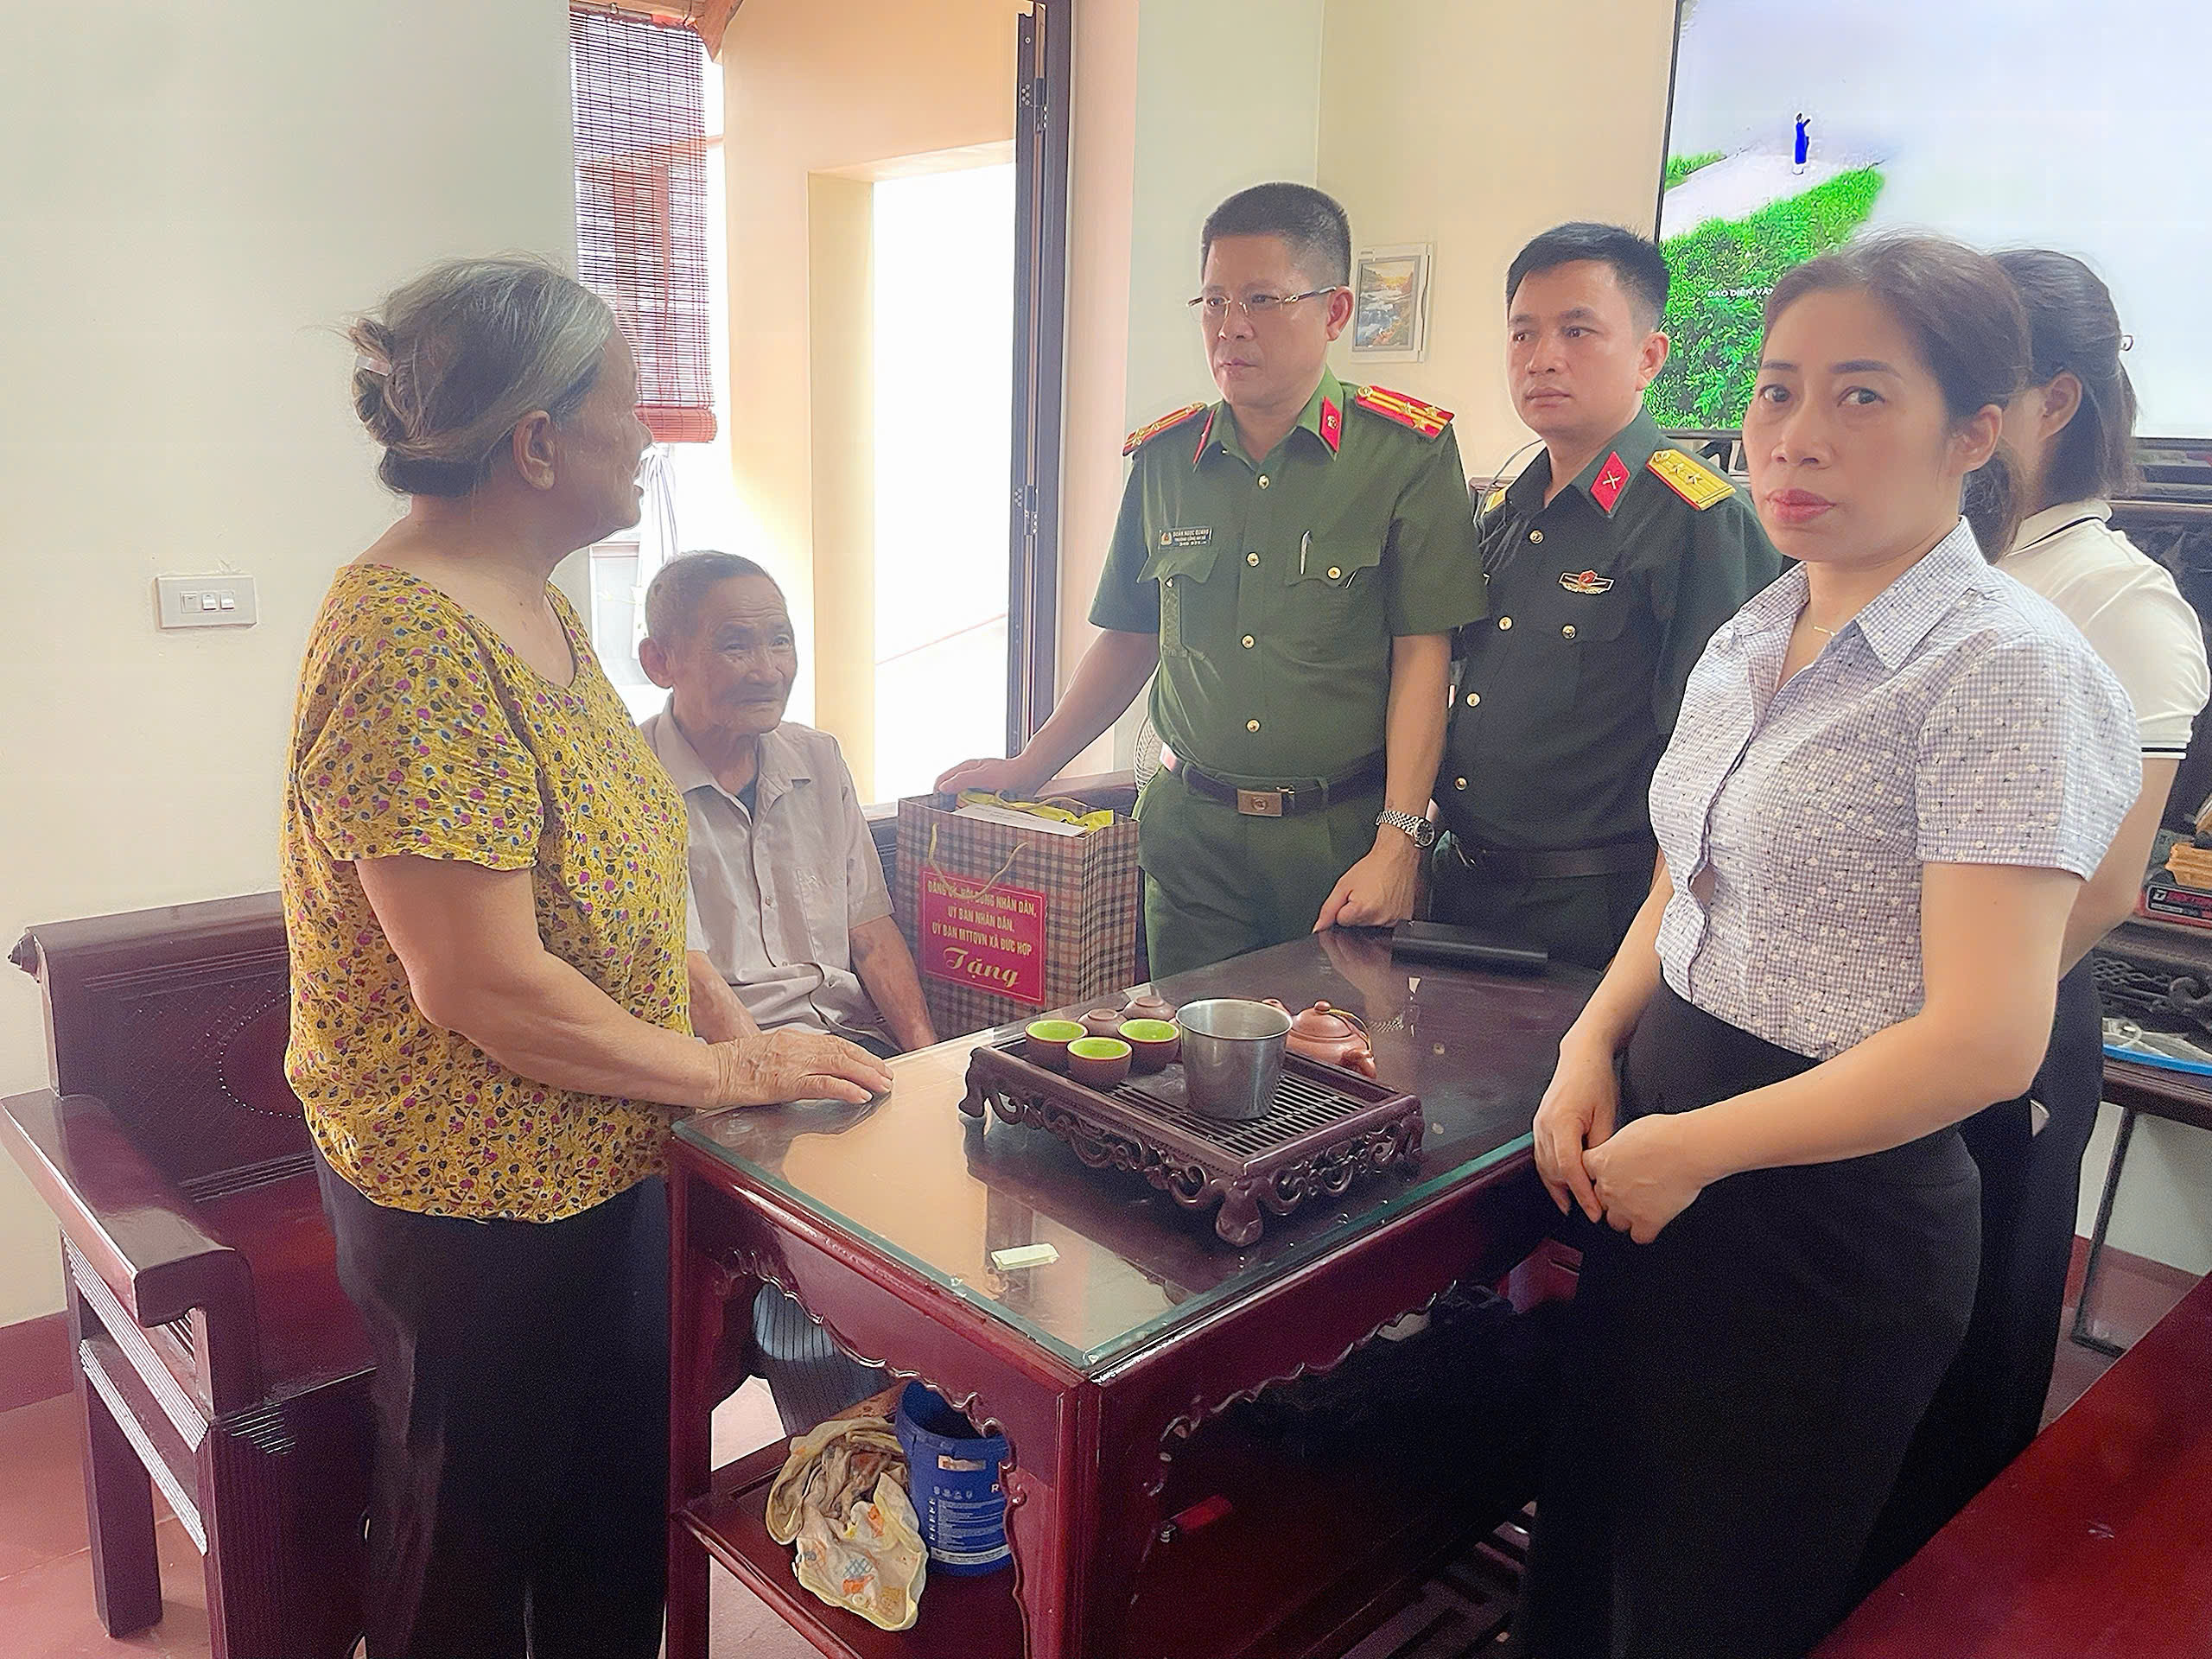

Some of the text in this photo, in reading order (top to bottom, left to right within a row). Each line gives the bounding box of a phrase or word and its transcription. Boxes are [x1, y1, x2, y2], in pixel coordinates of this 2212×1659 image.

[995, 893, 1016, 912] NHÂN
[958, 907, 974, 923] BAN
[975, 911, 995, 928] NHÂN
[943, 924, 957, 939] BAN
[959, 928, 988, 946] MTTQVN
[988, 933, 999, 949] XÃ
[1000, 936, 1015, 952] ĐỨC
[1017, 940, 1033, 958] HỢP
[943, 946, 1019, 988] Tặng
